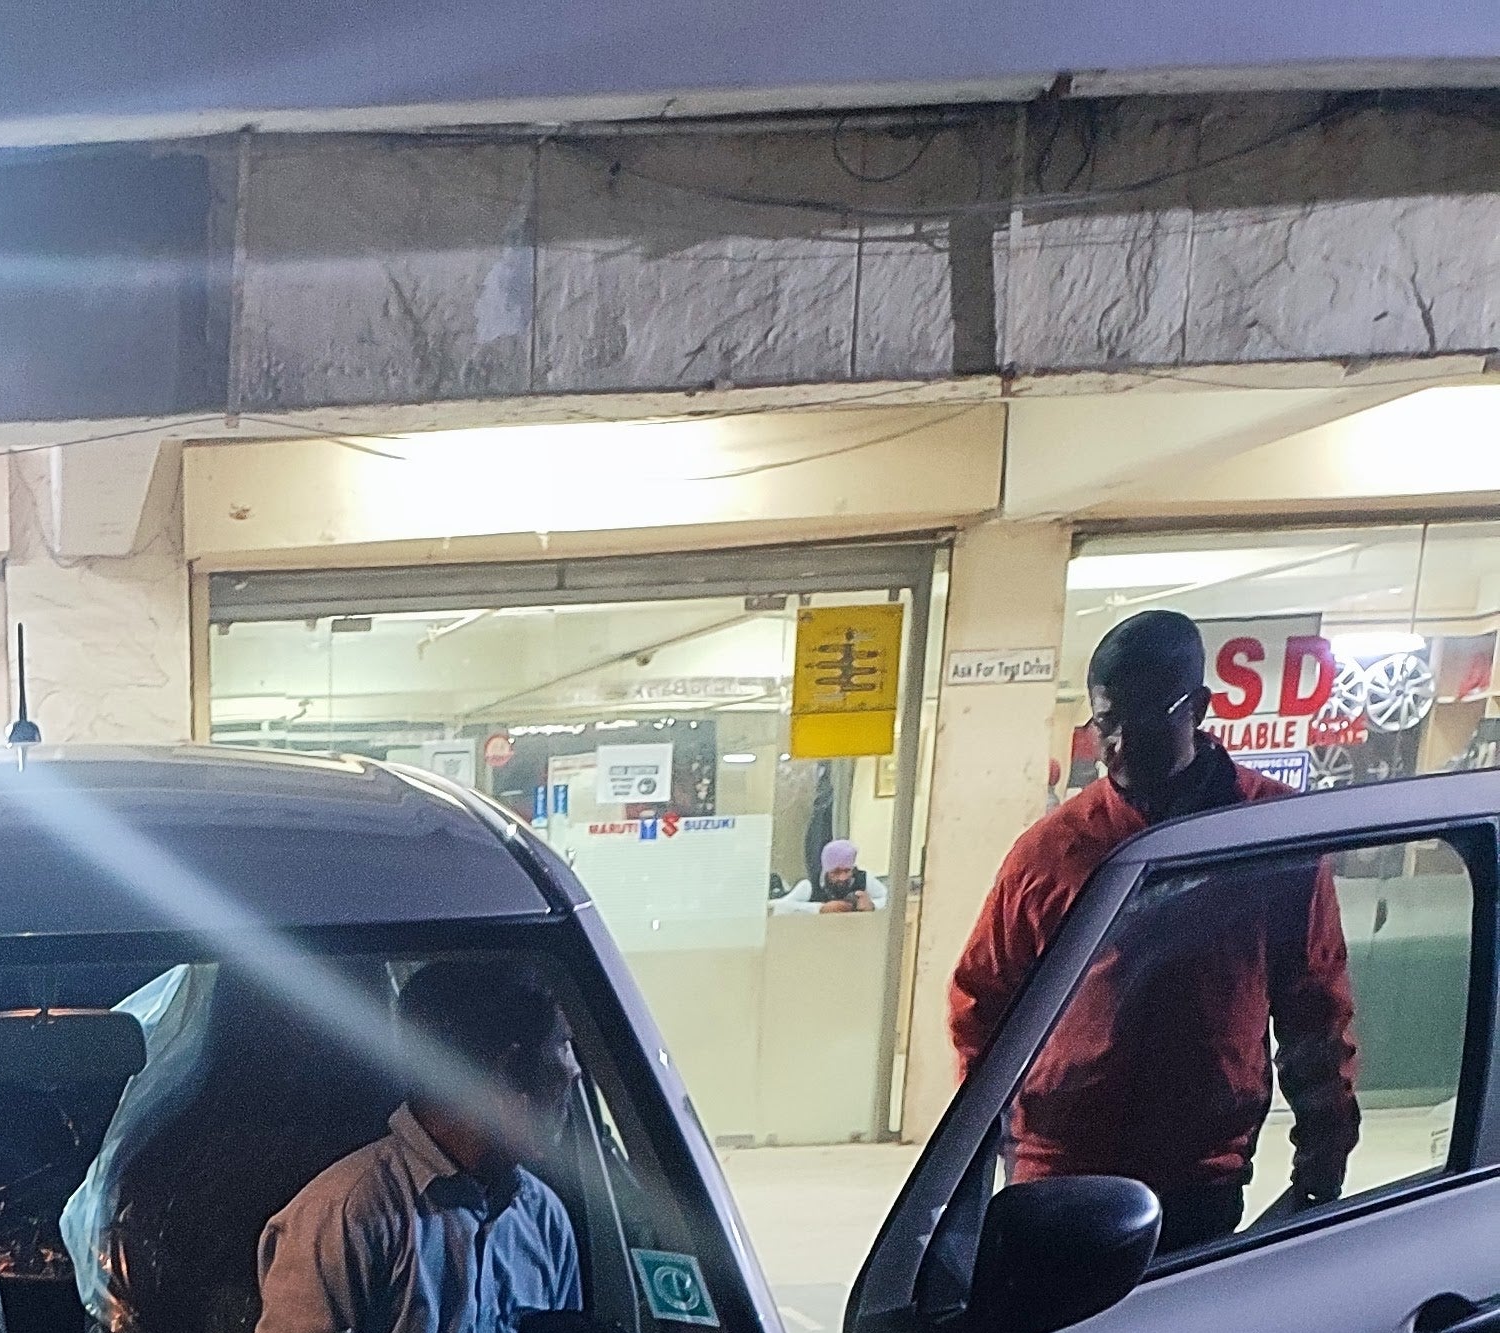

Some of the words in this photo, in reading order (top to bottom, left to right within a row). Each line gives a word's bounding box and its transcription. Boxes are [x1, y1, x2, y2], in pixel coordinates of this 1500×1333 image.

[976, 662, 995, 677] For
[1023, 657, 1051, 676] Drive
[589, 823, 638, 835] MARUTI
[683, 818, 736, 831] SUZUKI
